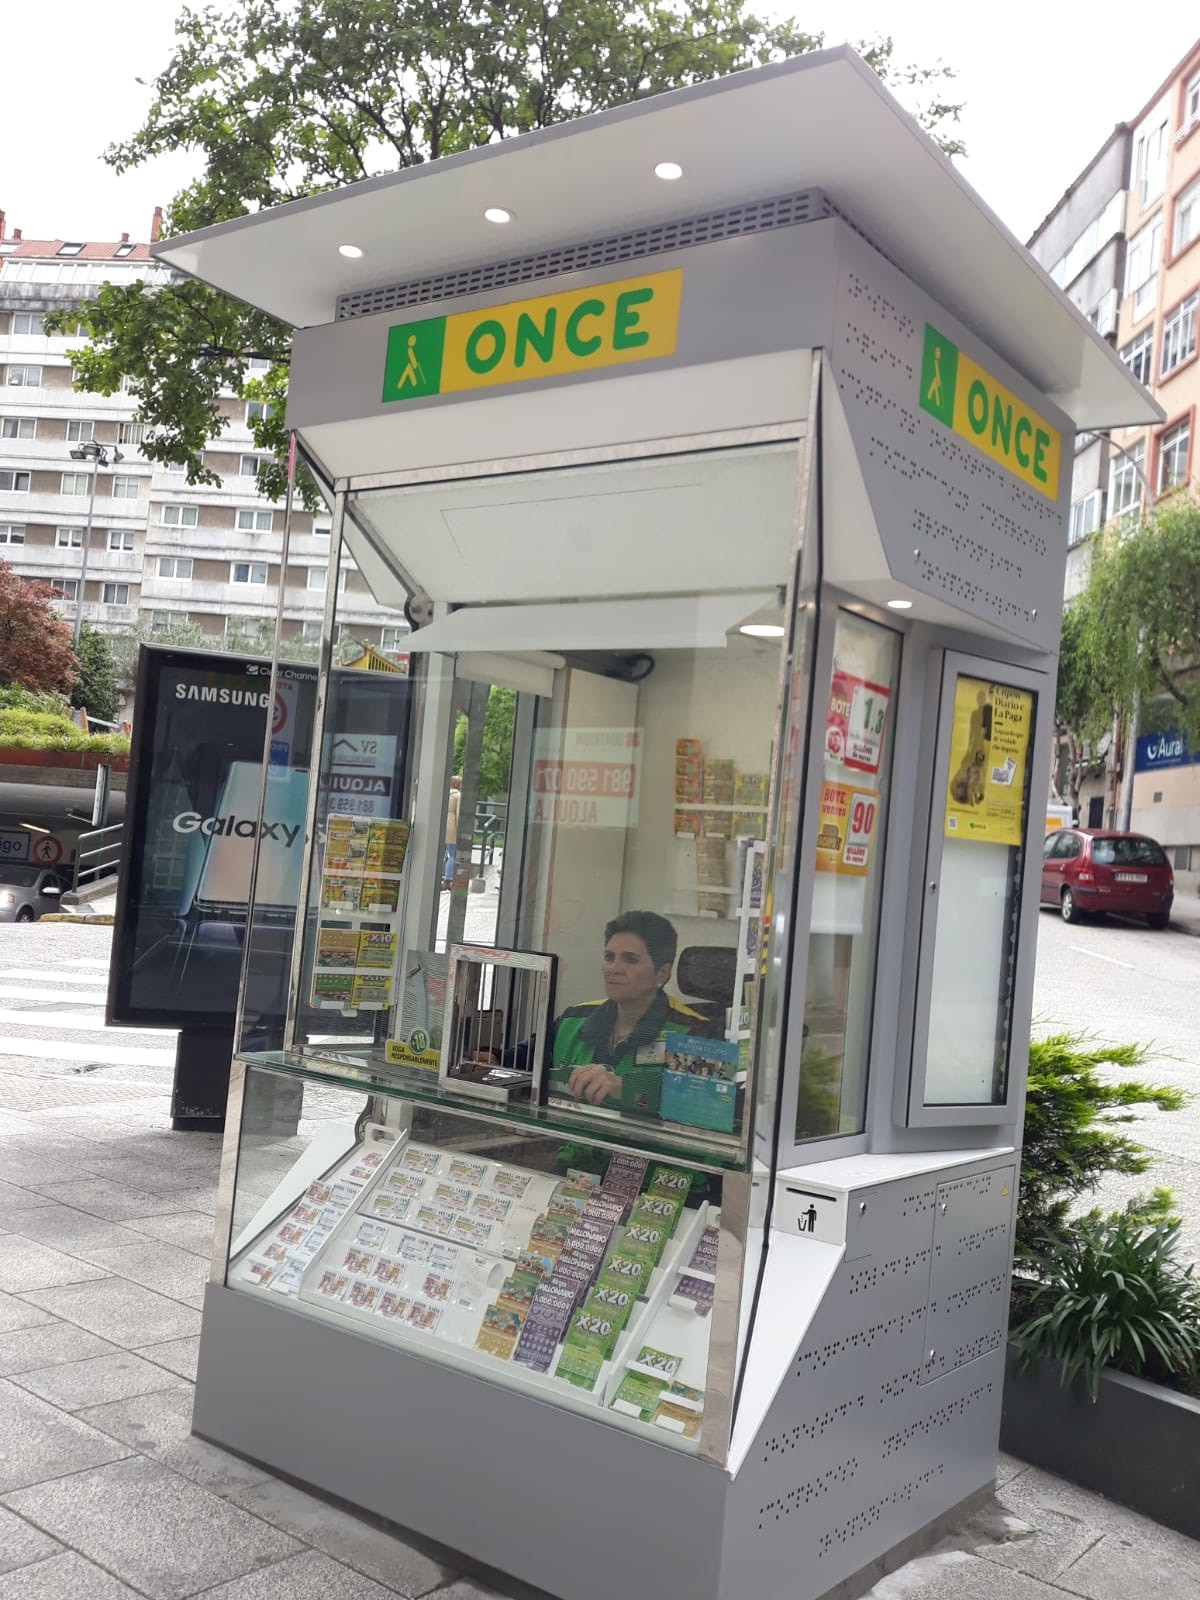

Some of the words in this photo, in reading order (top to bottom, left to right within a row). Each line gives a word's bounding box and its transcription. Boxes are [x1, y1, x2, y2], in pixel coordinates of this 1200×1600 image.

[466, 287, 654, 375] ONCE
[967, 379, 1051, 483] ONCE
[285, 670, 319, 681] Channe
[175, 683, 270, 709] SAMSUNG
[830, 696, 851, 717] BOTE
[851, 800, 875, 835] 90
[172, 811, 302, 849] Galaxy
[653, 1172, 688, 1191] X20
[640, 1199, 674, 1217] X20
[625, 1225, 660, 1245] X20
[607, 1257, 643, 1277] X20
[593, 1286, 630, 1306] X20
[575, 1314, 612, 1336] X20
[639, 1351, 678, 1373] X20
